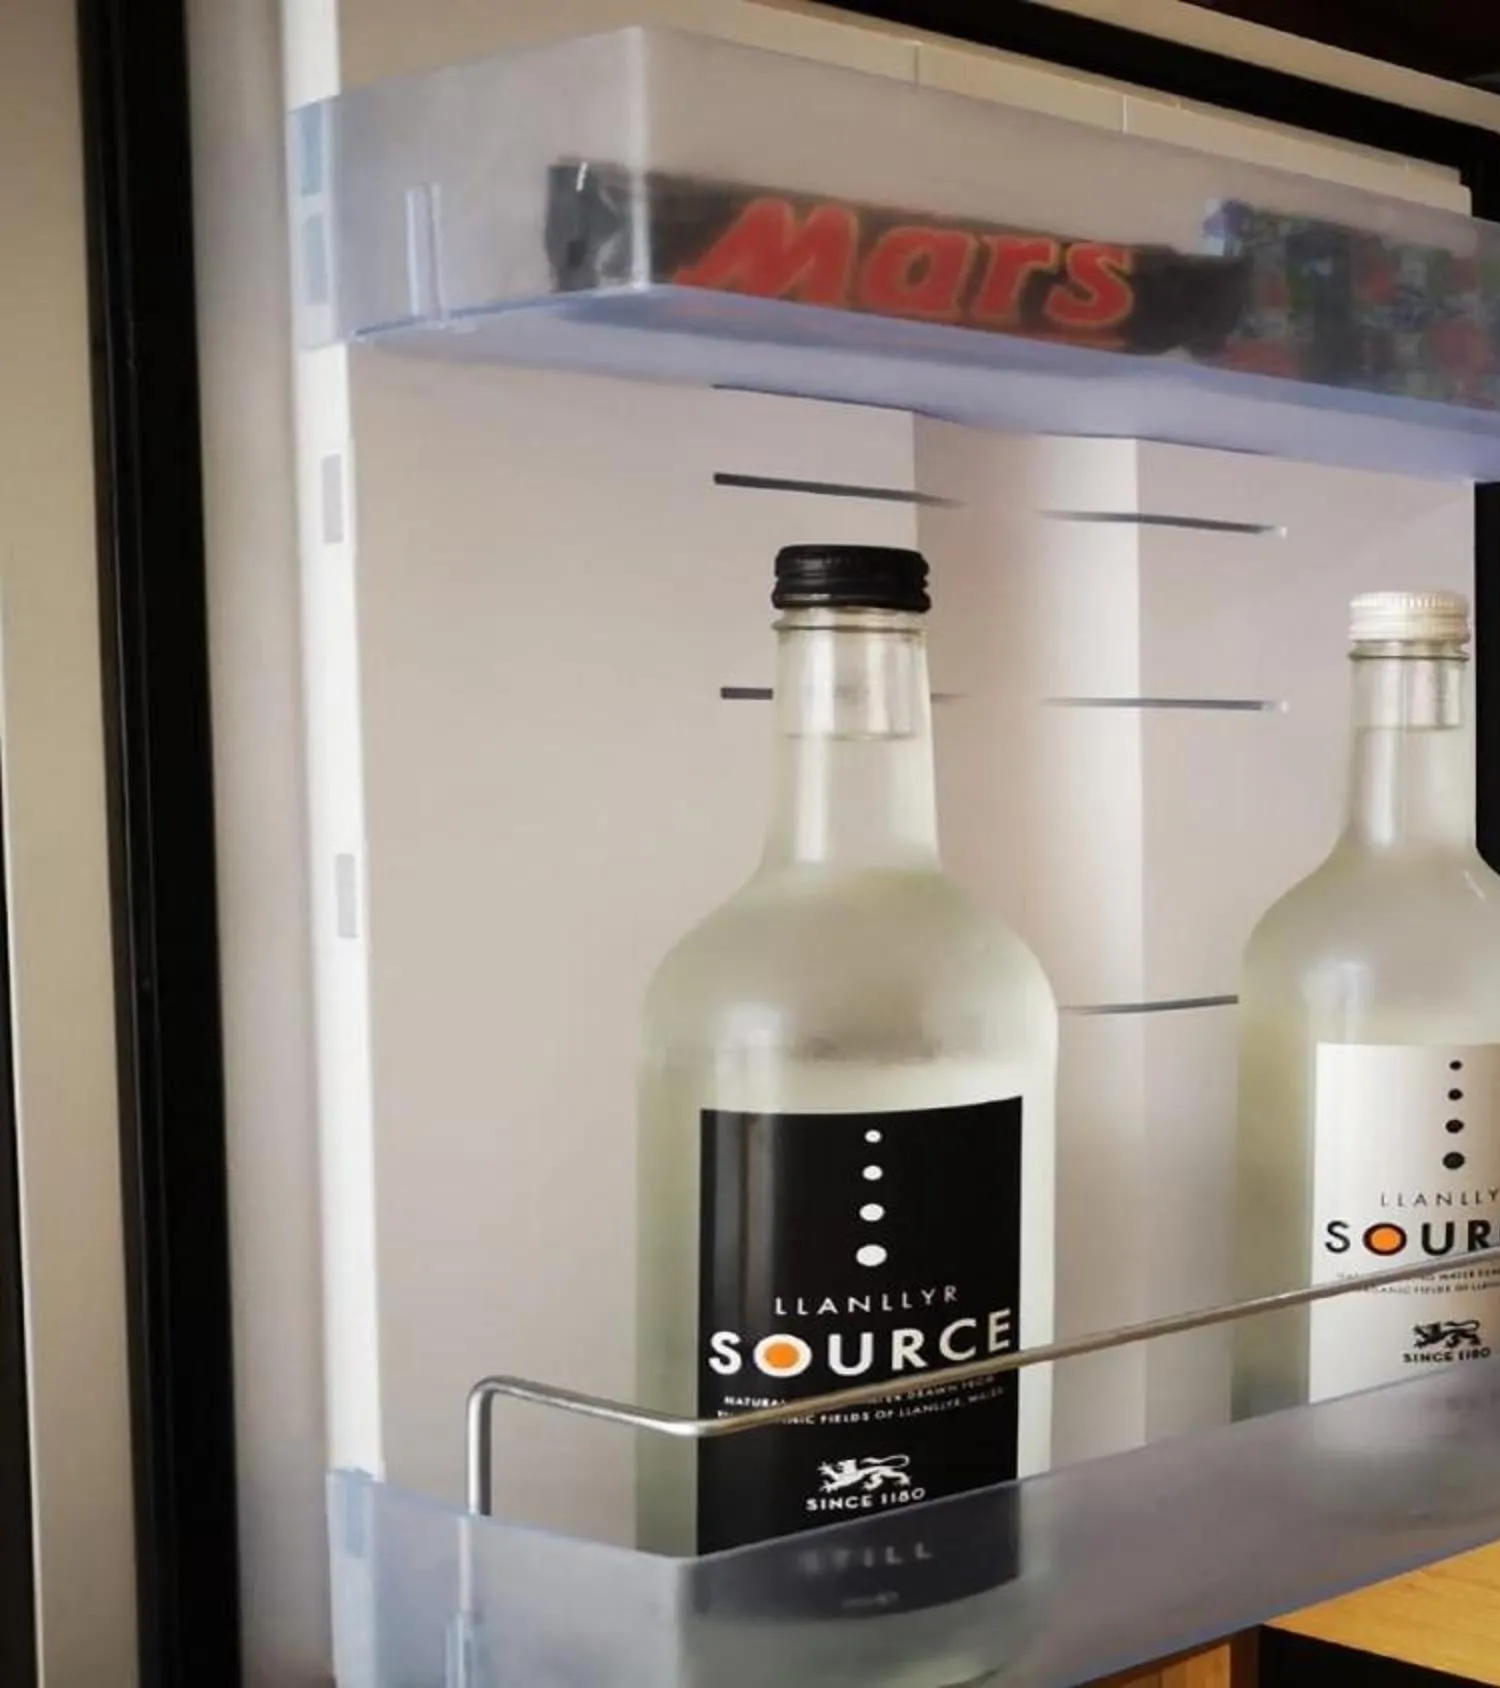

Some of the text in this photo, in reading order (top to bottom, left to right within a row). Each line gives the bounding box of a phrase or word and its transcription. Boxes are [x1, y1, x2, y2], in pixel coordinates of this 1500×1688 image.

[674, 199, 1137, 327] Mars
[775, 1285, 959, 1316] LLANLLYR
[708, 1308, 1012, 1378] SOURCE
[1402, 1350, 1454, 1364] SINCE
[820, 1411, 870, 1424] FIELDS
[874, 1409, 894, 1420] OF
[805, 1487, 927, 1512] SINCE 1180
